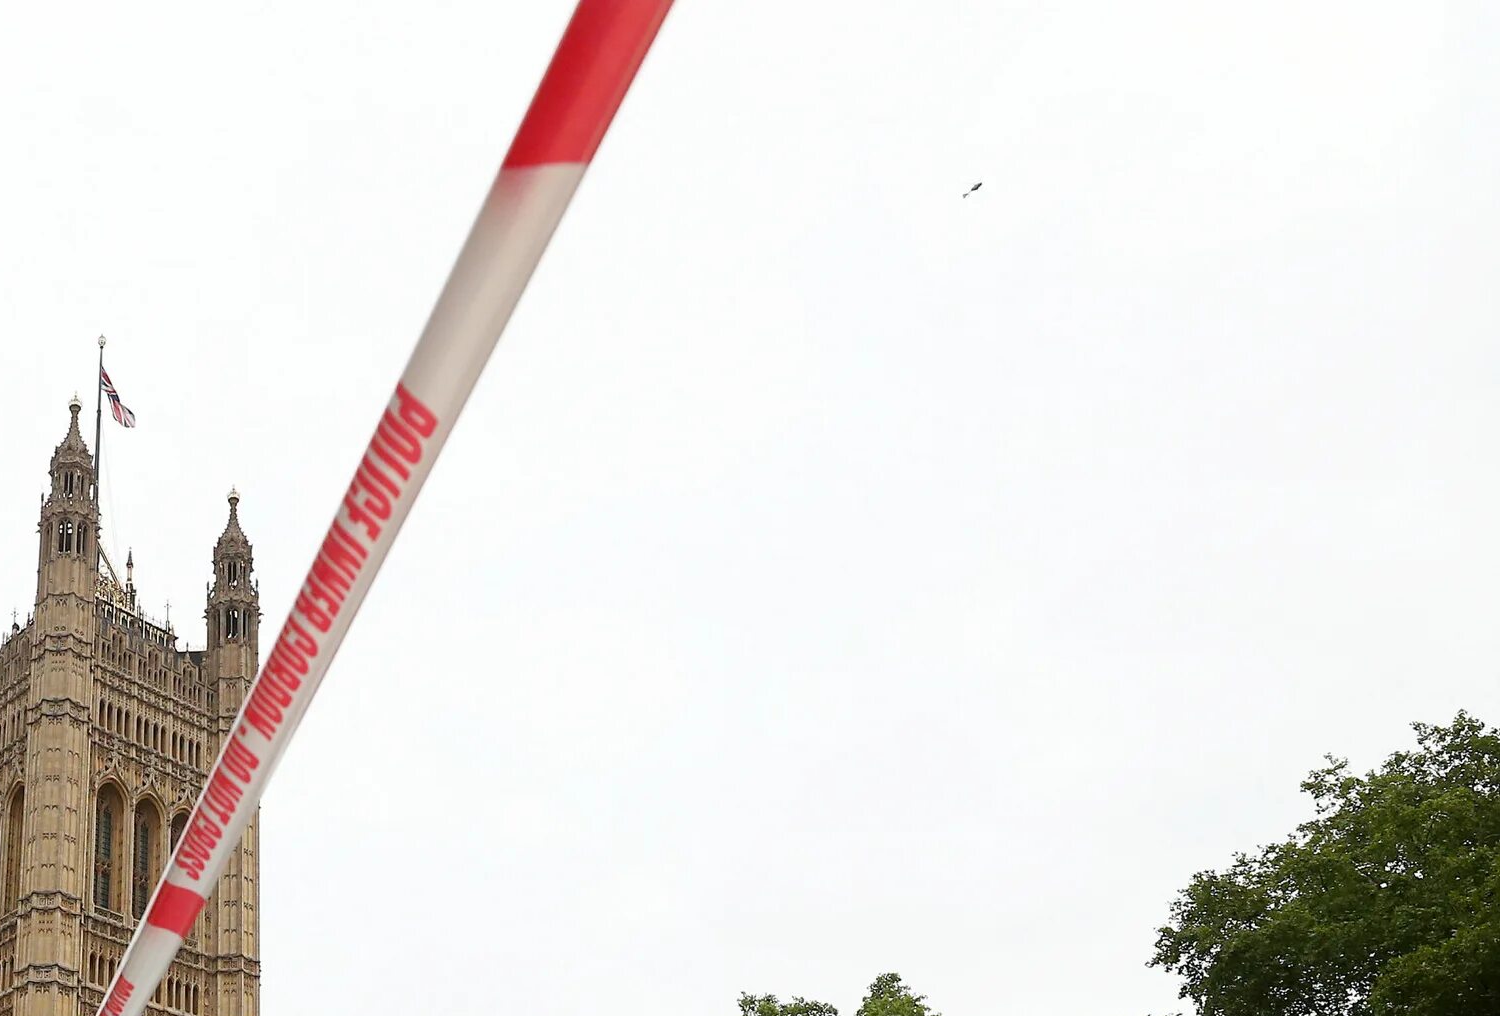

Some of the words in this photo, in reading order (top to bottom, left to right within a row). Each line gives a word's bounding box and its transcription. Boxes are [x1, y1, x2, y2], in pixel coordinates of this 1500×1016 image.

[344, 381, 438, 542] POLICE
[295, 520, 369, 633] INNER
[245, 611, 319, 741] CORDON
[202, 765, 244, 826] NOT
[220, 734, 260, 785] DO
[174, 805, 223, 881] CROSS
